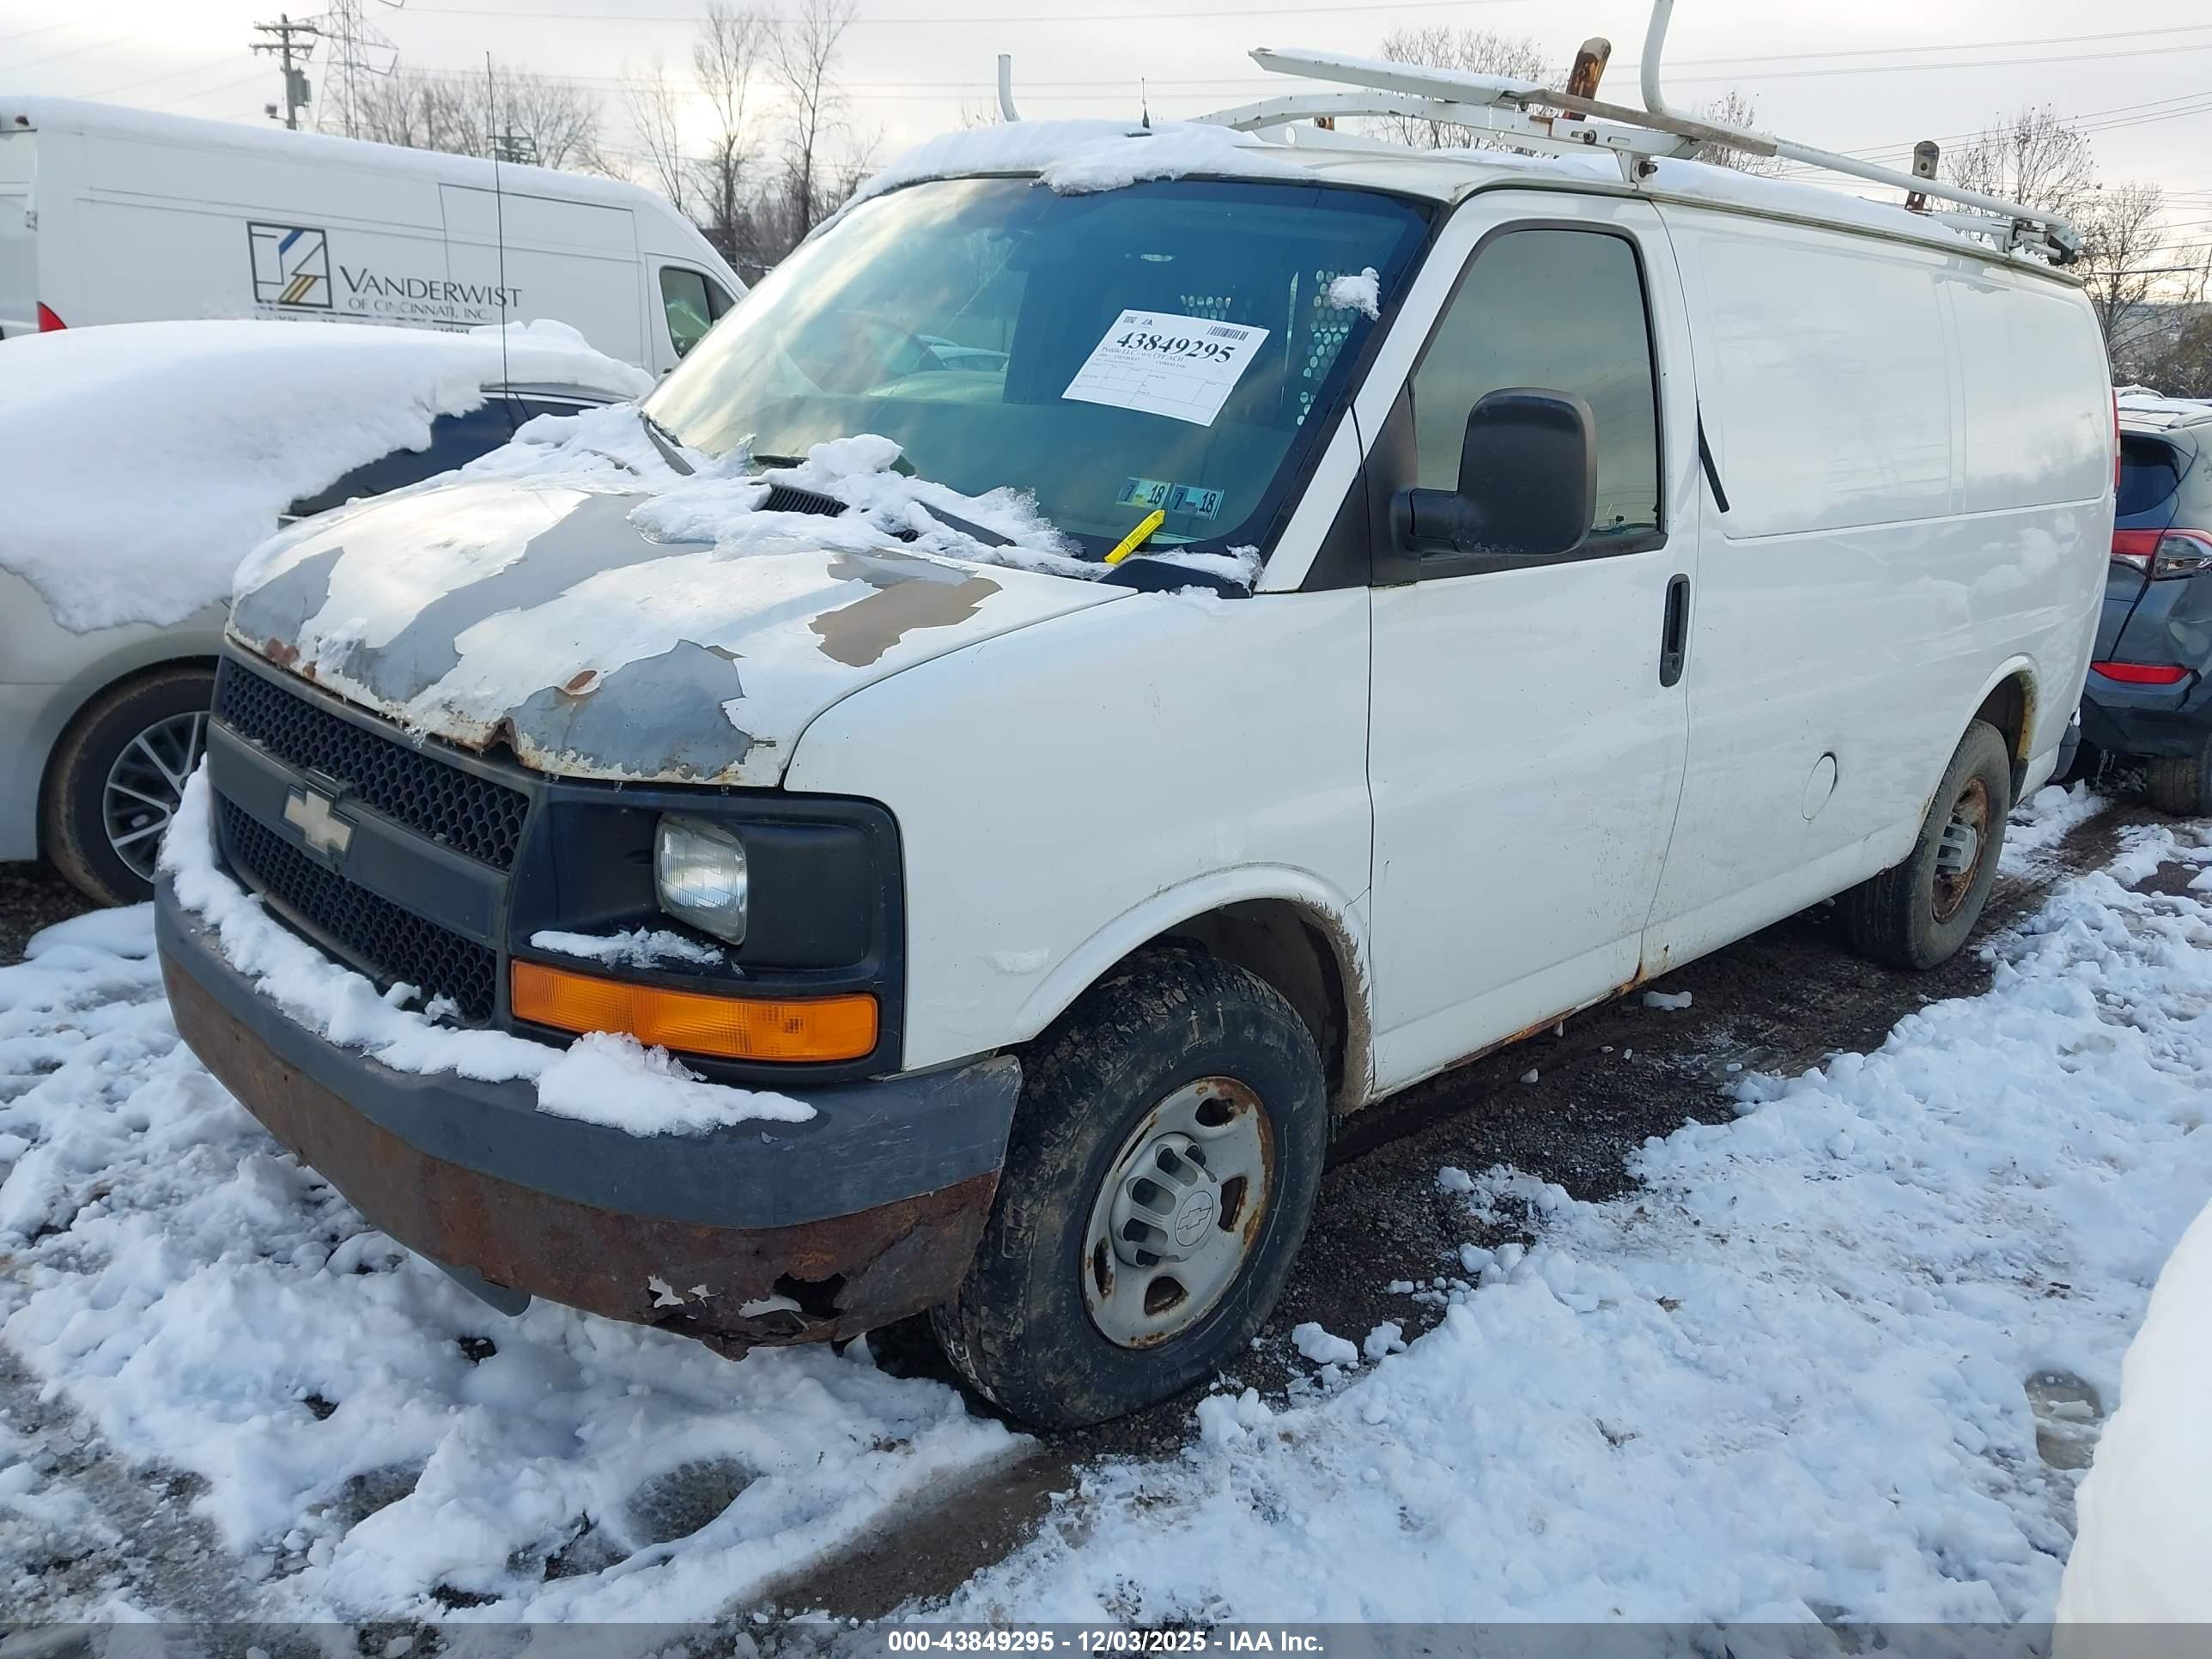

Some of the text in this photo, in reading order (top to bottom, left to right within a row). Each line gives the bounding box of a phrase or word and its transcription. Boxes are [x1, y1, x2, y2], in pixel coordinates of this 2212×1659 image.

[339, 265, 522, 308] VANDERWIST
[348, 297, 367, 310] OF
[464, 307, 492, 321] INC.
[1117, 331, 1237, 363] 43849295
[1123, 484, 1165, 505] 7 18
[1174, 491, 1217, 513] 7 18
